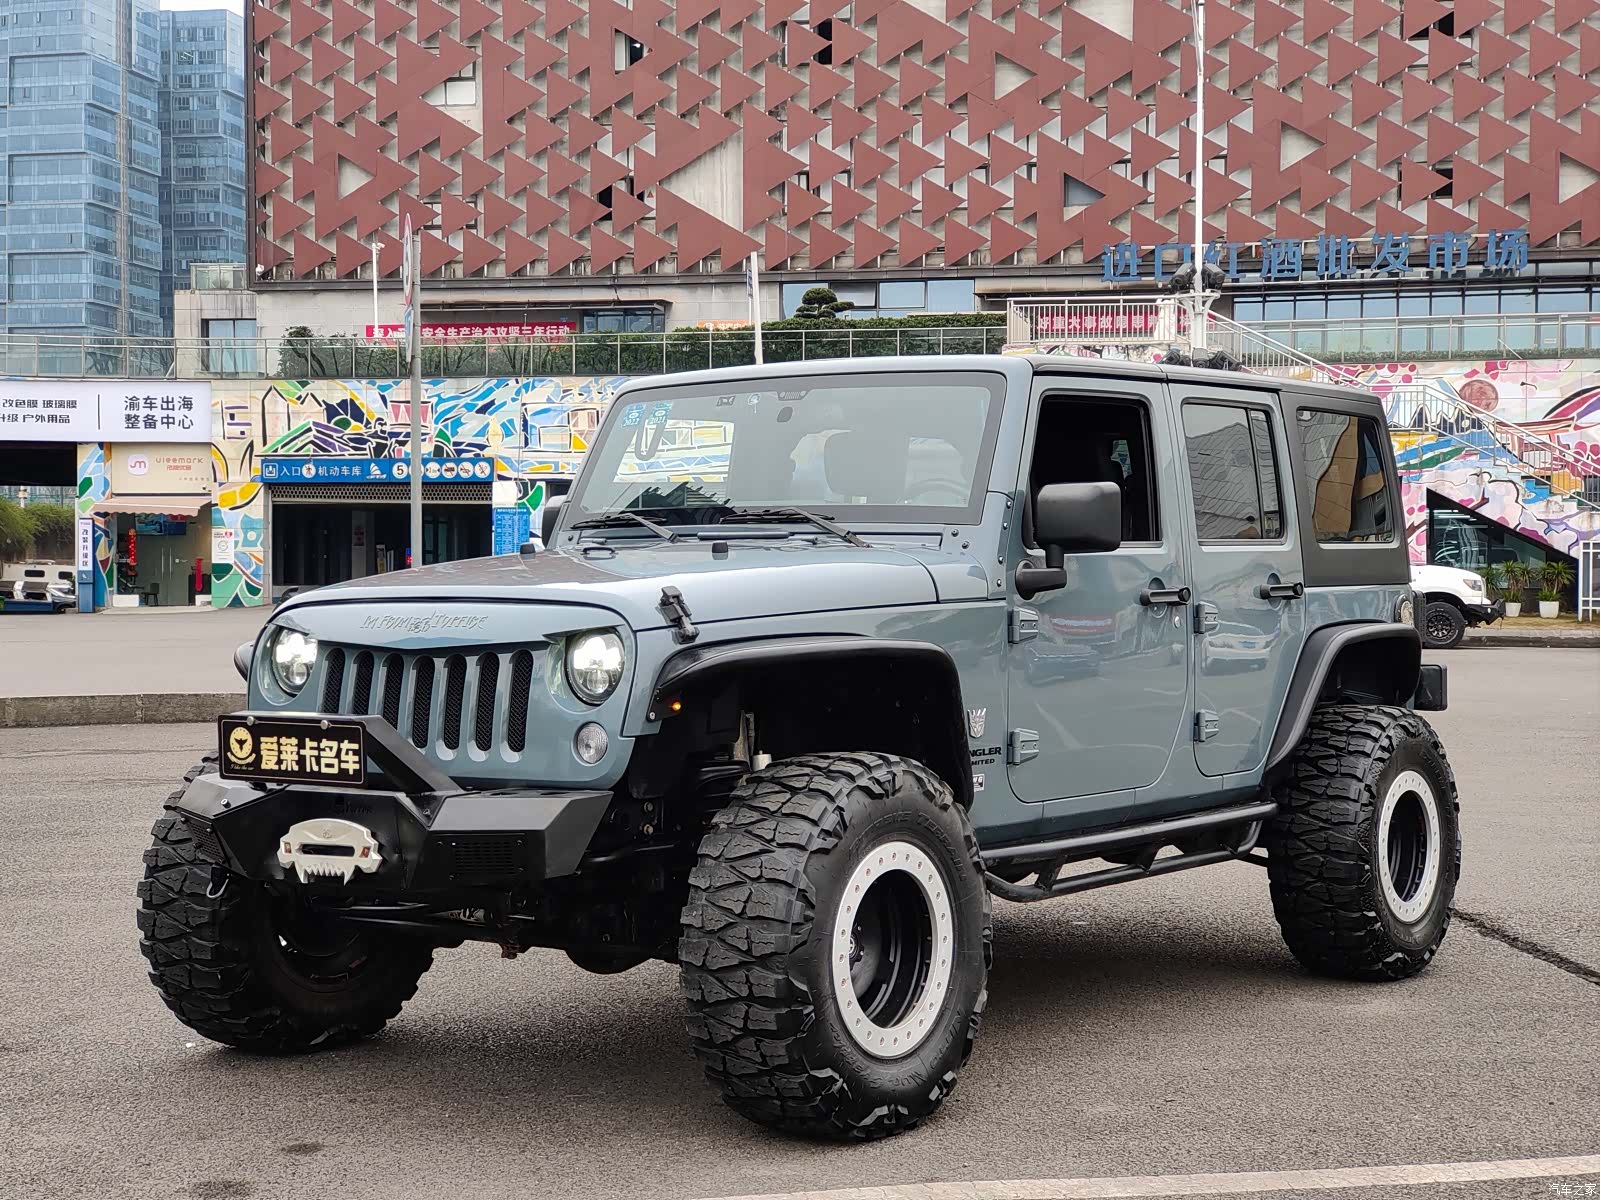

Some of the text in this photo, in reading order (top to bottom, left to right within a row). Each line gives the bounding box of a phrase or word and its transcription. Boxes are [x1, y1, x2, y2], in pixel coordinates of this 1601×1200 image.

[1101, 228, 1528, 282] 进口红酒批发市场
[2, 399, 77, 409] 改色膜 玻璃膜
[124, 395, 193, 412] 渝车出海
[22, 414, 70, 424] 户外用品
[124, 413, 194, 429] 整备中心
[280, 465, 362, 477] 入口 机动车库
[397, 465, 404, 475] 5
[260, 736, 360, 775] 爱莱卡名车
